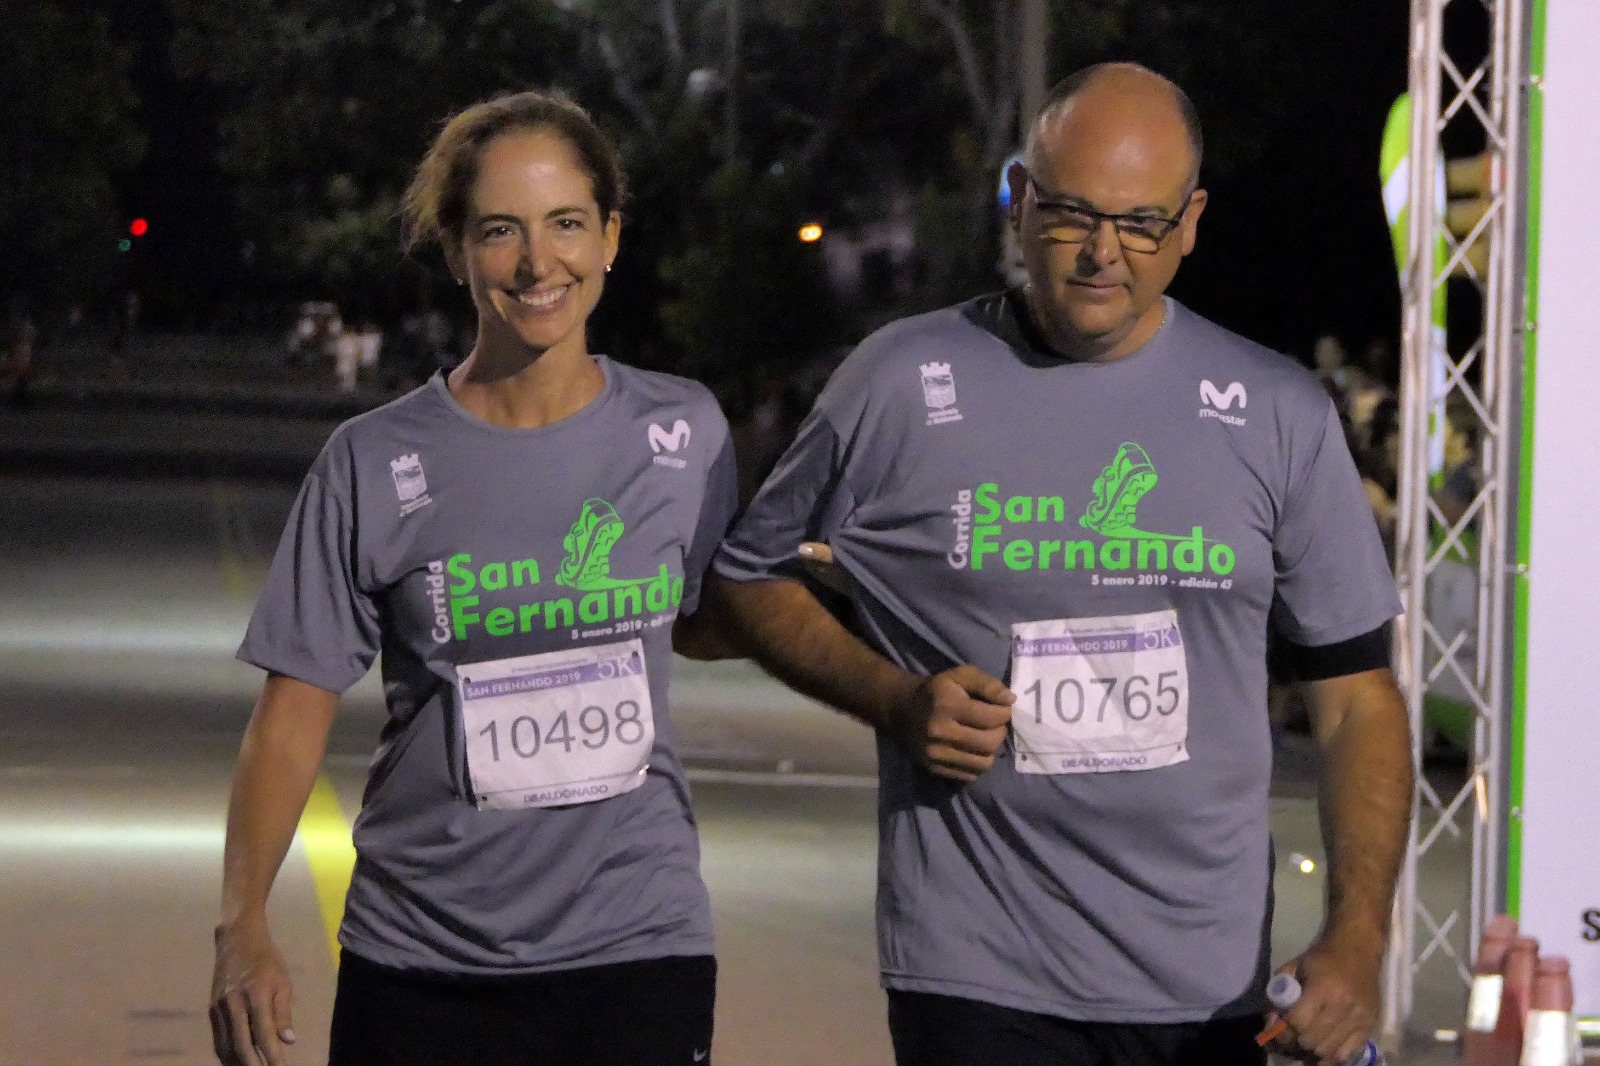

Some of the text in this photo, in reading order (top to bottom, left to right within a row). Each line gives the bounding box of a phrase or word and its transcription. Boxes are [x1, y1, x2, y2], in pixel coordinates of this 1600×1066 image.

[973, 482, 1065, 524] San
[948, 489, 972, 570] Corrida
[970, 525, 1236, 575] Fernando
[447, 553, 541, 597] San
[1091, 573, 1100, 586] 5
[1102, 575, 1135, 586] enero
[1137, 573, 1169, 587] 2019
[426, 560, 451, 644] Corrida
[1016, 638, 1129, 654] SAN FERNANDO 2019
[1143, 627, 1175, 649] 5K
[466, 670, 582, 698] SAN FERNANDO 2019
[597, 655, 635, 681] 5K
[1023, 669, 1180, 724] 10765
[479, 699, 646, 762] 10498
